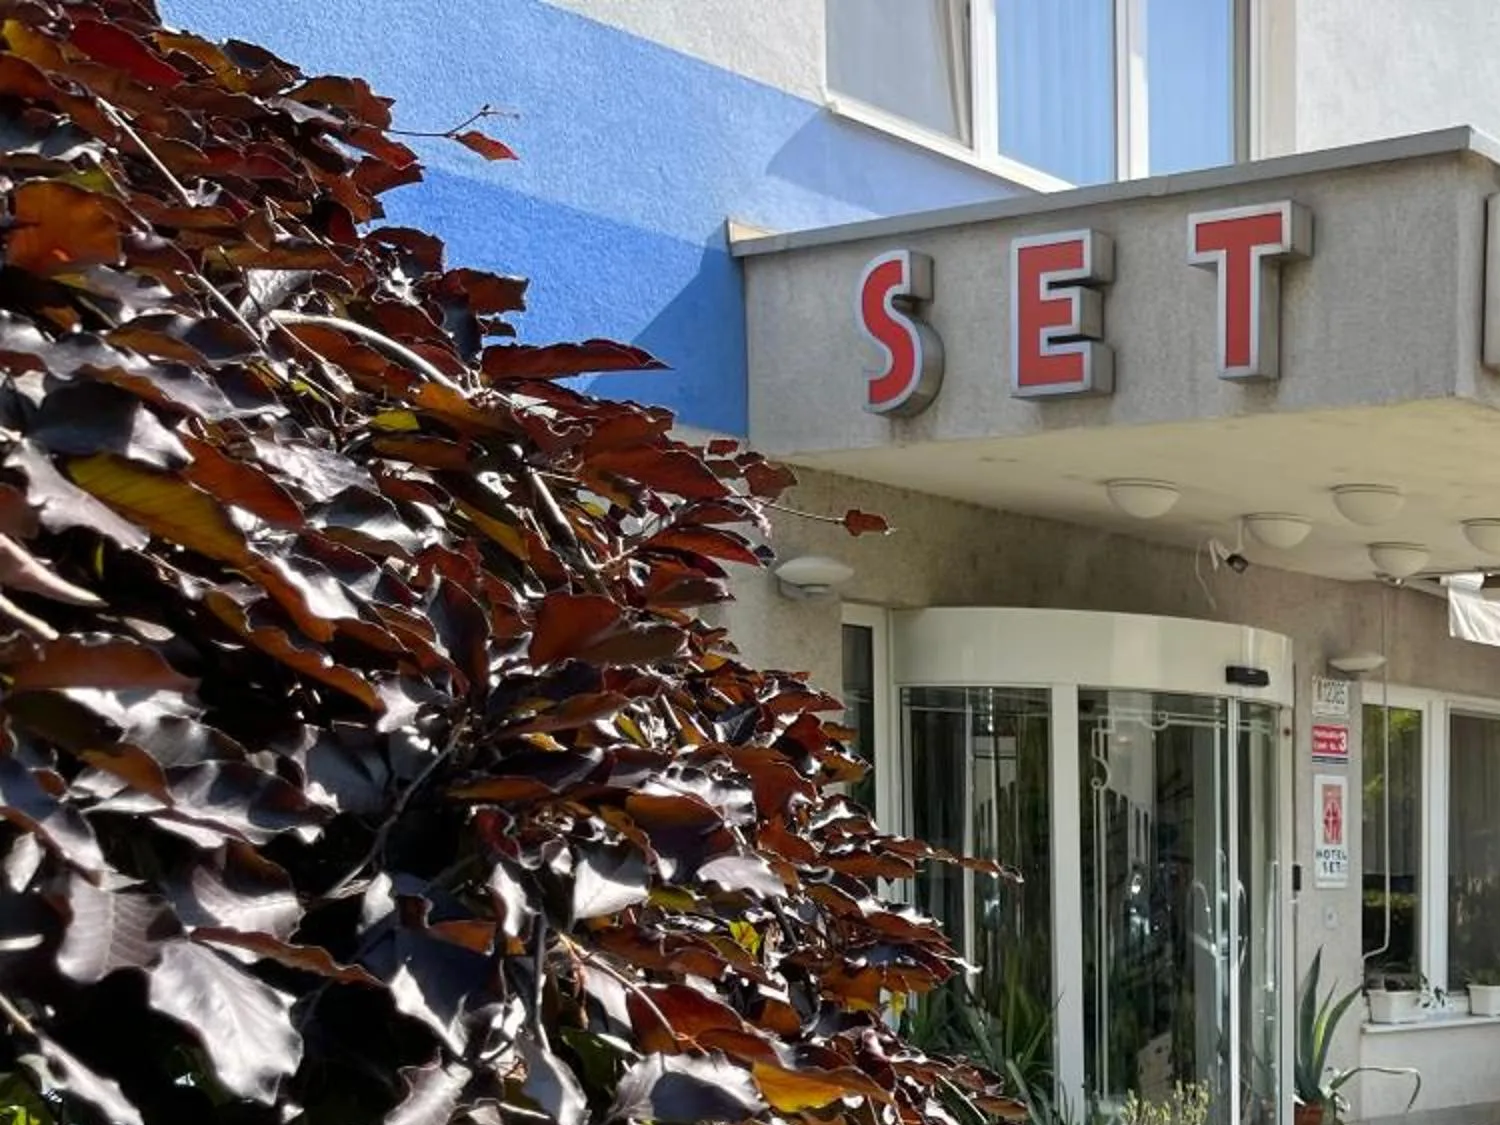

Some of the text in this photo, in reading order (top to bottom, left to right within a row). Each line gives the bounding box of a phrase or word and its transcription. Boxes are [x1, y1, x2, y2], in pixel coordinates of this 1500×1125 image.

[856, 200, 1310, 416] SET
[1316, 849, 1348, 861] HOTEL
[1322, 861, 1341, 874] SET
